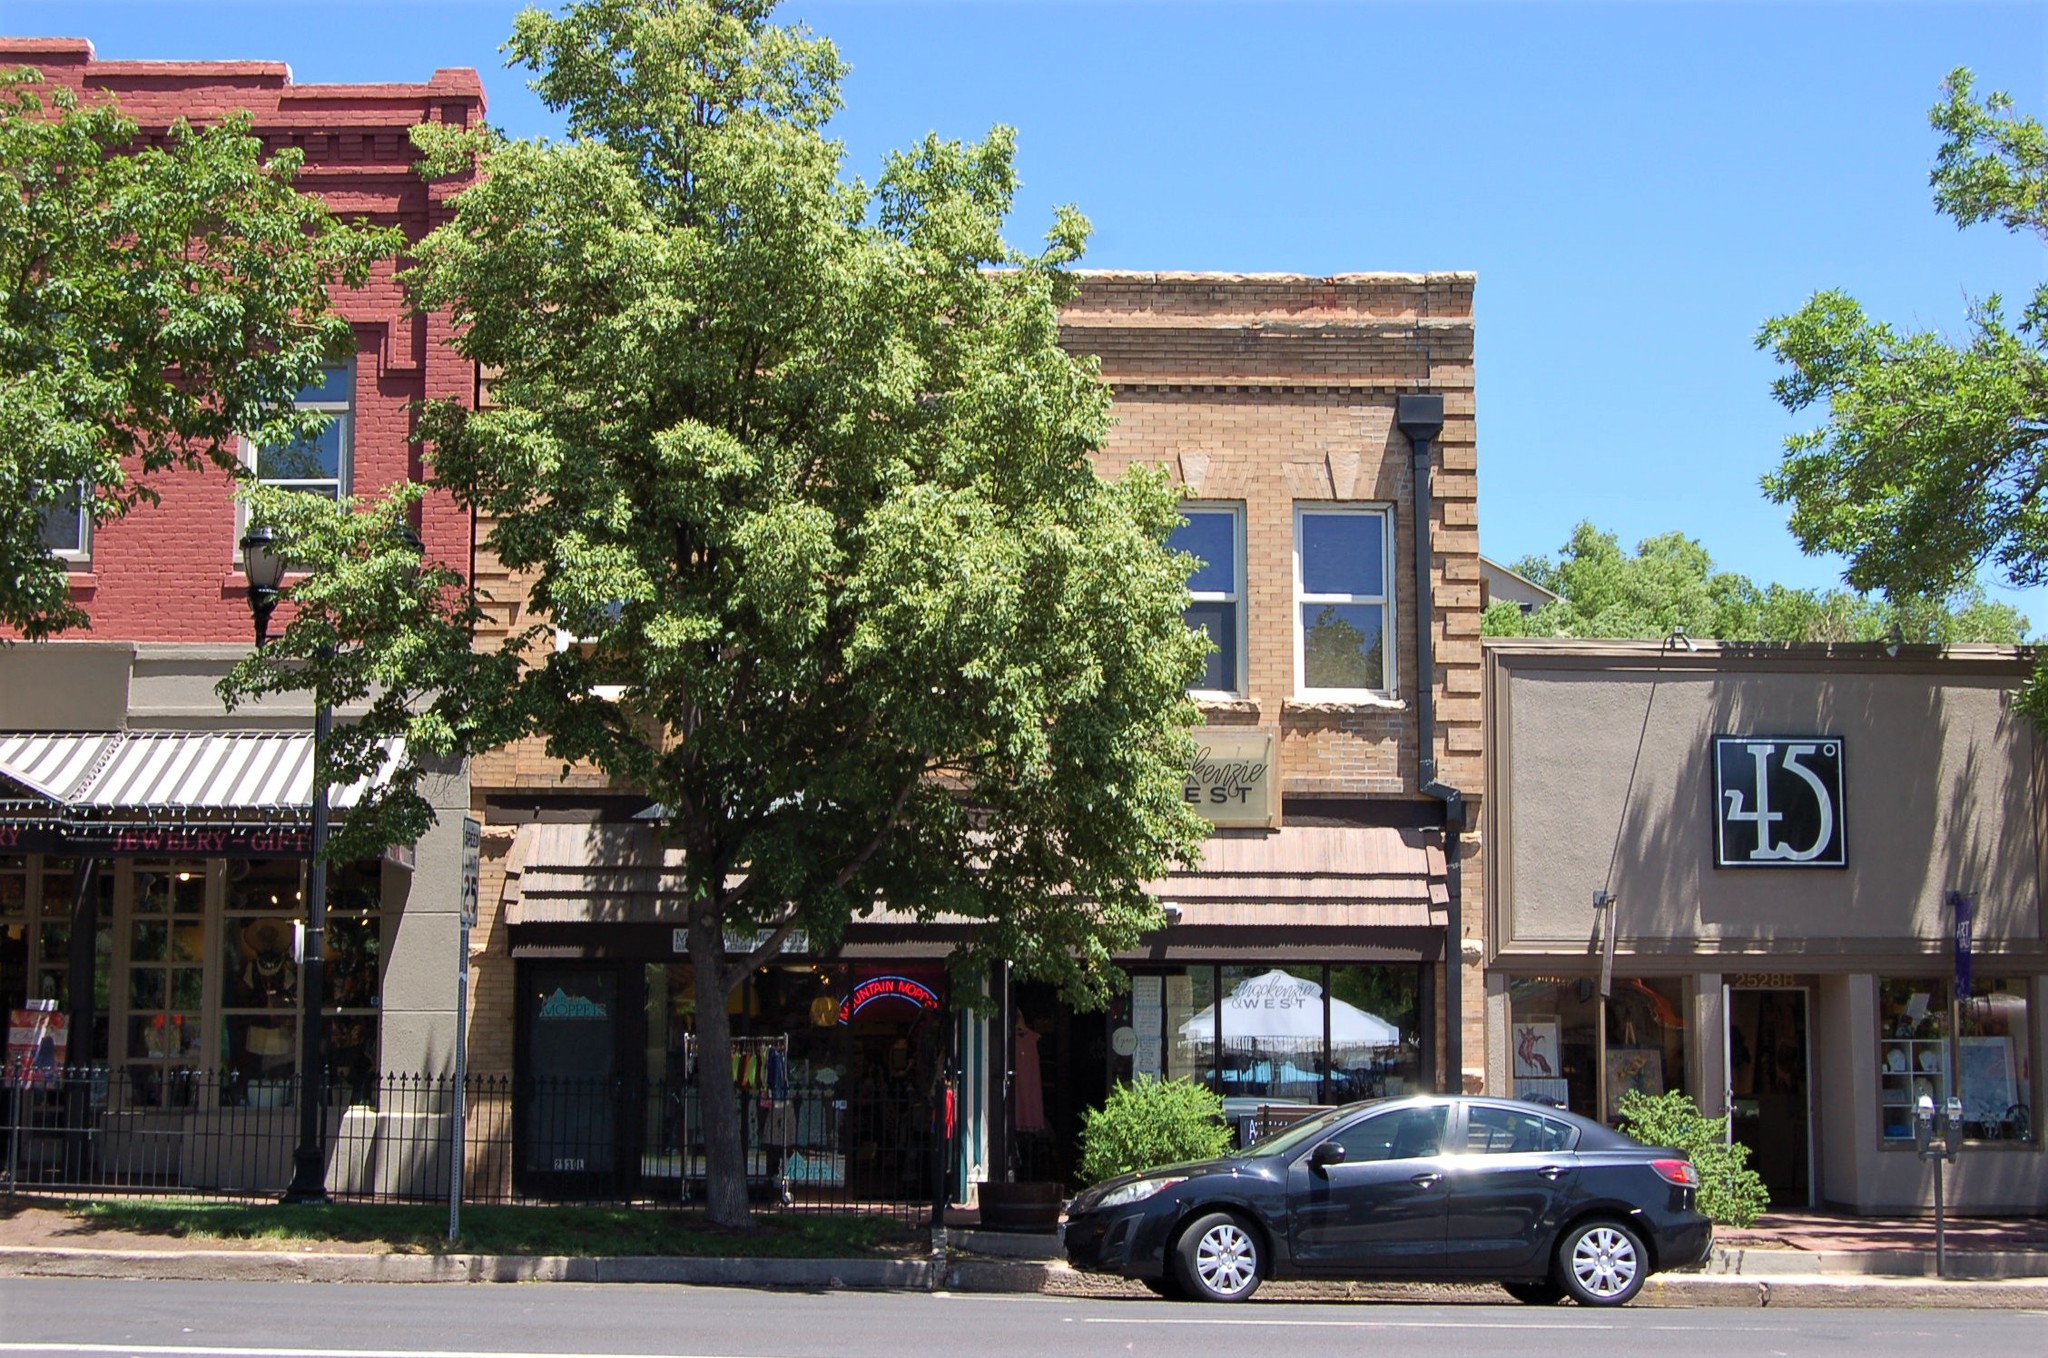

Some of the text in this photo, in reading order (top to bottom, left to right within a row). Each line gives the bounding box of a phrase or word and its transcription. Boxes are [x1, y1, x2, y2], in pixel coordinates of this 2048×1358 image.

[1184, 787, 1252, 803] EST
[113, 831, 227, 851] JEWELRY
[250, 831, 312, 851] GIFT
[465, 829, 479, 848] SPEED
[463, 875, 478, 914] 25
[1956, 921, 1970, 939] ART
[1735, 973, 1795, 987] 2528B
[840, 980, 895, 1021] MUNTAIN
